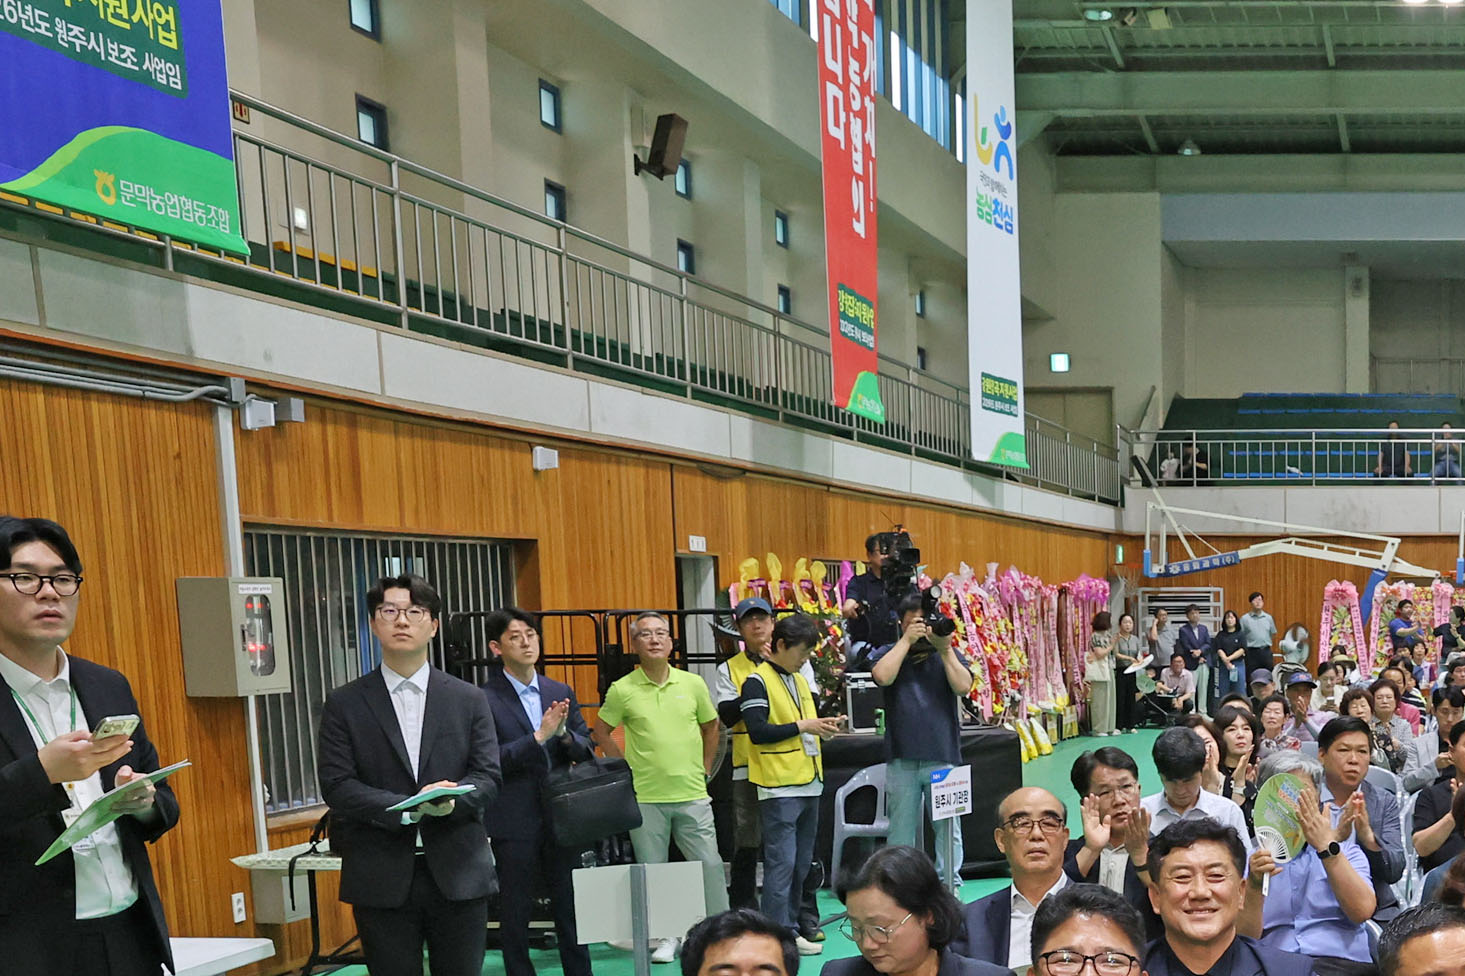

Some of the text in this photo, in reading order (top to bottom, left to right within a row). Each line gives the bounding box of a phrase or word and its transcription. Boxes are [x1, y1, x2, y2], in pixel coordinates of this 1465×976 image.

[54, 16, 105, 61] 원주시
[107, 38, 139, 71] 보조
[143, 52, 182, 91] 사업임
[119, 178, 230, 234] 문막농업협동조합
[934, 790, 969, 809] 원주시 기관장
